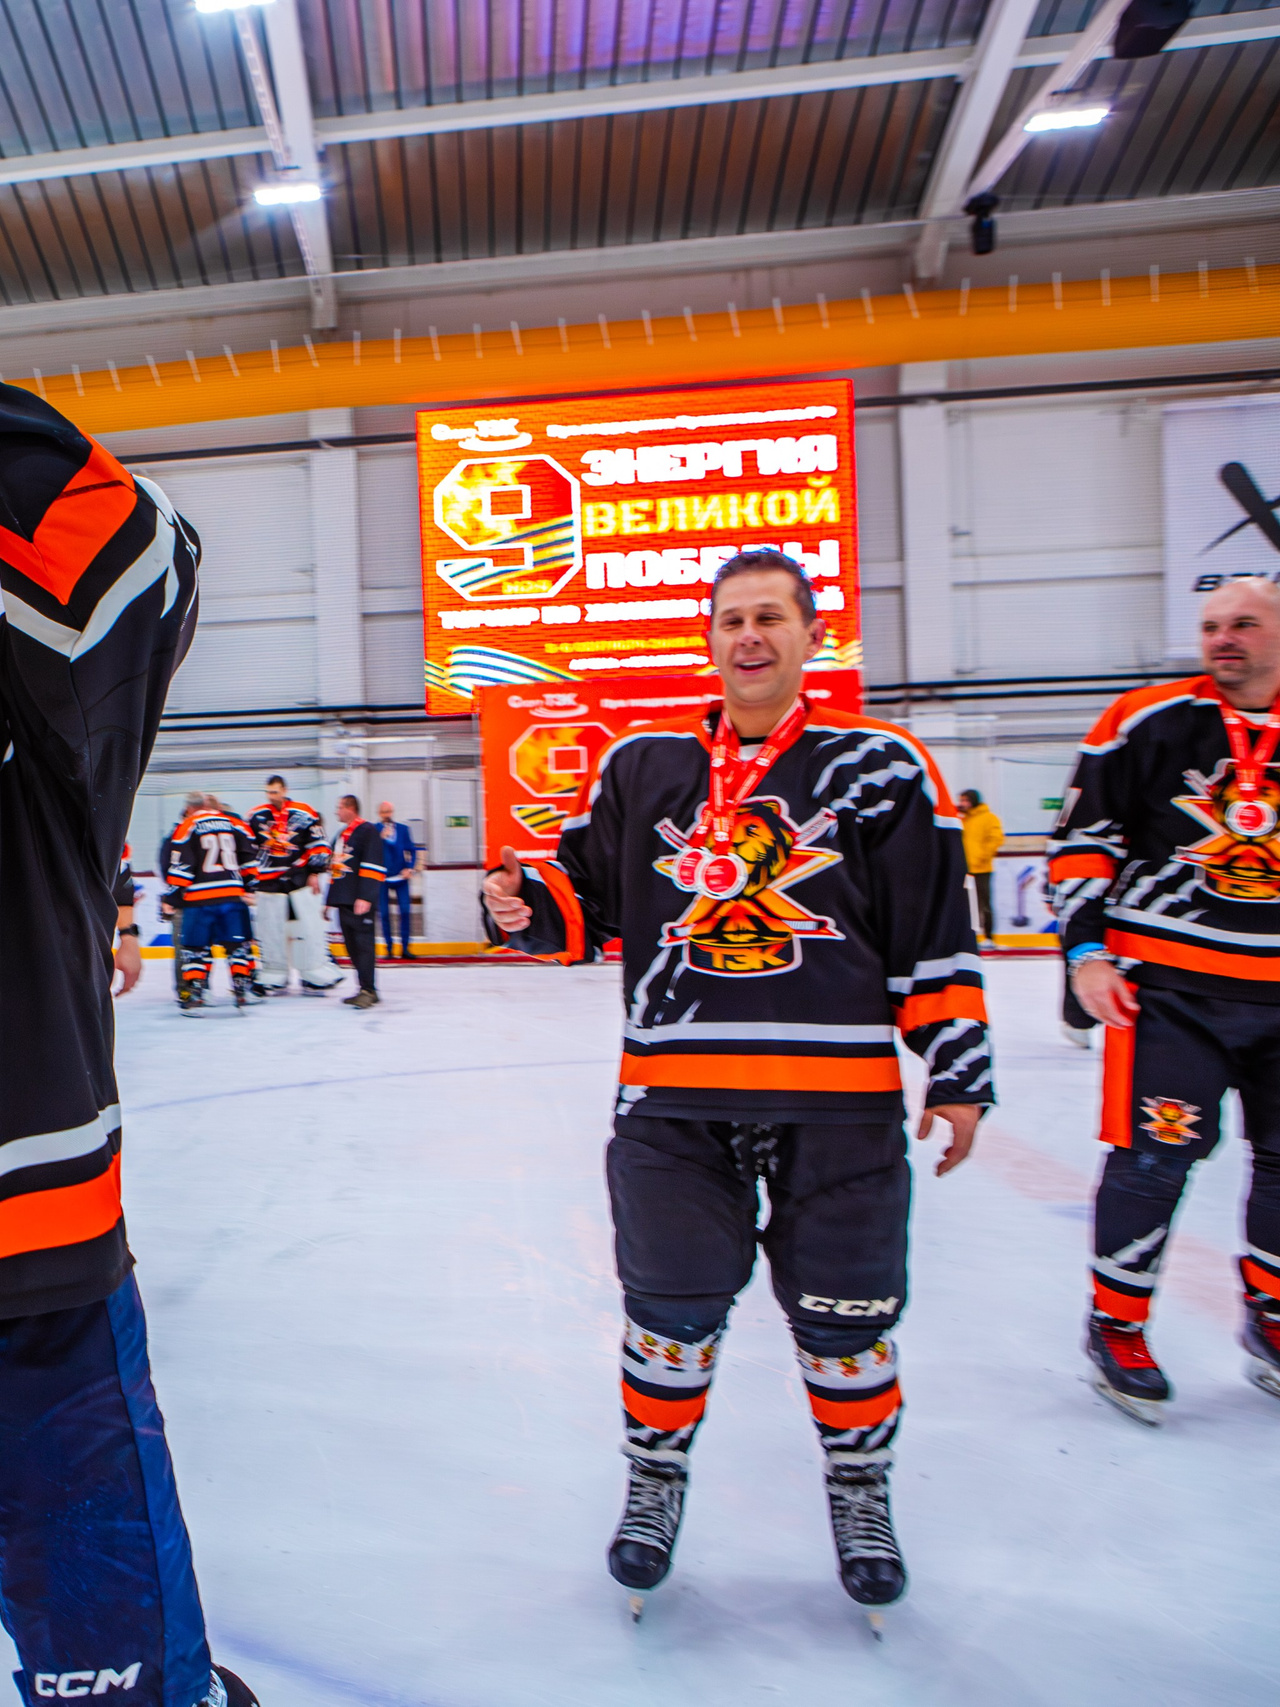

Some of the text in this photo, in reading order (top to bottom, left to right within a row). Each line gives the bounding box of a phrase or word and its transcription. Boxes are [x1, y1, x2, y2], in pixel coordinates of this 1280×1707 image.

[580, 434, 838, 486] ЭНЕРГИЯ
[433, 454, 583, 602] 9
[581, 475, 840, 537] ВЕЛИКОЙ
[584, 539, 840, 589] ПОБЕЫ
[798, 1293, 900, 1317] CCM
[34, 1661, 143, 1698] CCM
